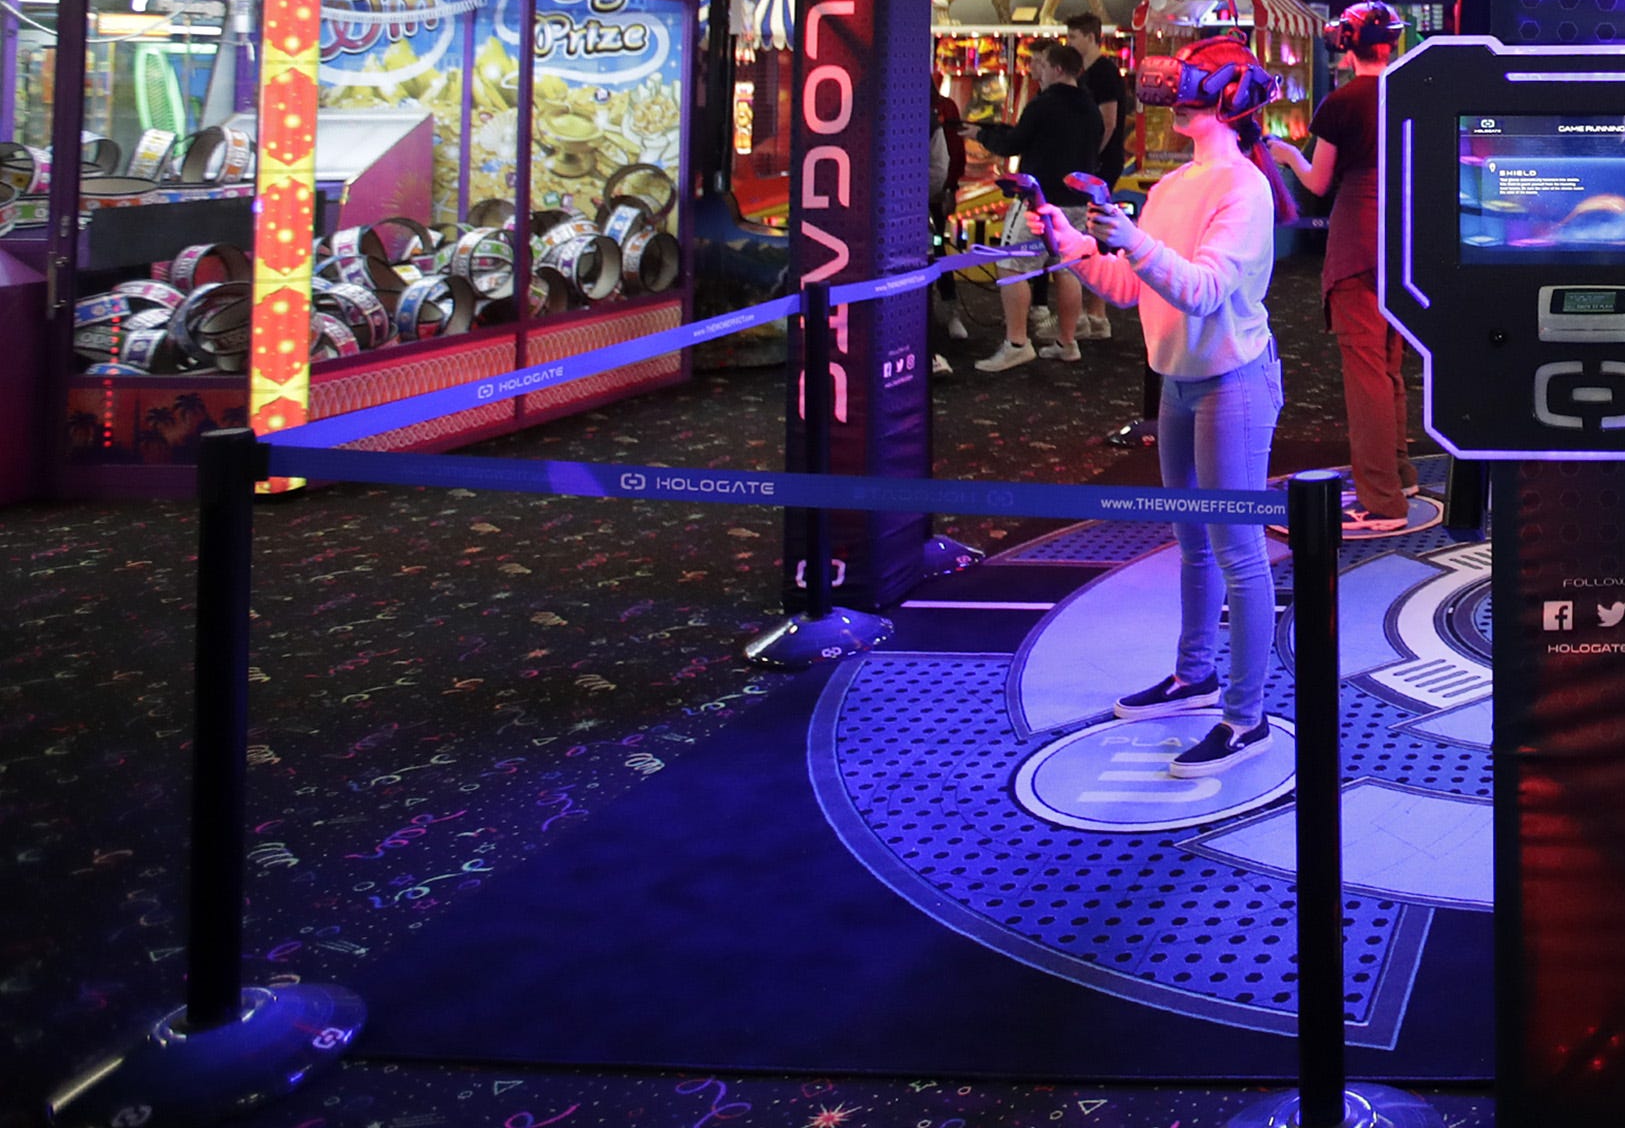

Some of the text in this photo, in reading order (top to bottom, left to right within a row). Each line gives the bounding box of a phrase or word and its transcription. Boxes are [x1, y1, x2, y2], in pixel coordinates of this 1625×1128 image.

[534, 13, 648, 59] Prize
[1558, 125, 1625, 133] GAME RUNNING
[499, 366, 563, 392] HOLOGATE
[656, 476, 775, 495] HOLOGATE
[1101, 497, 1286, 515] www.THEWOWEFFECT.com
